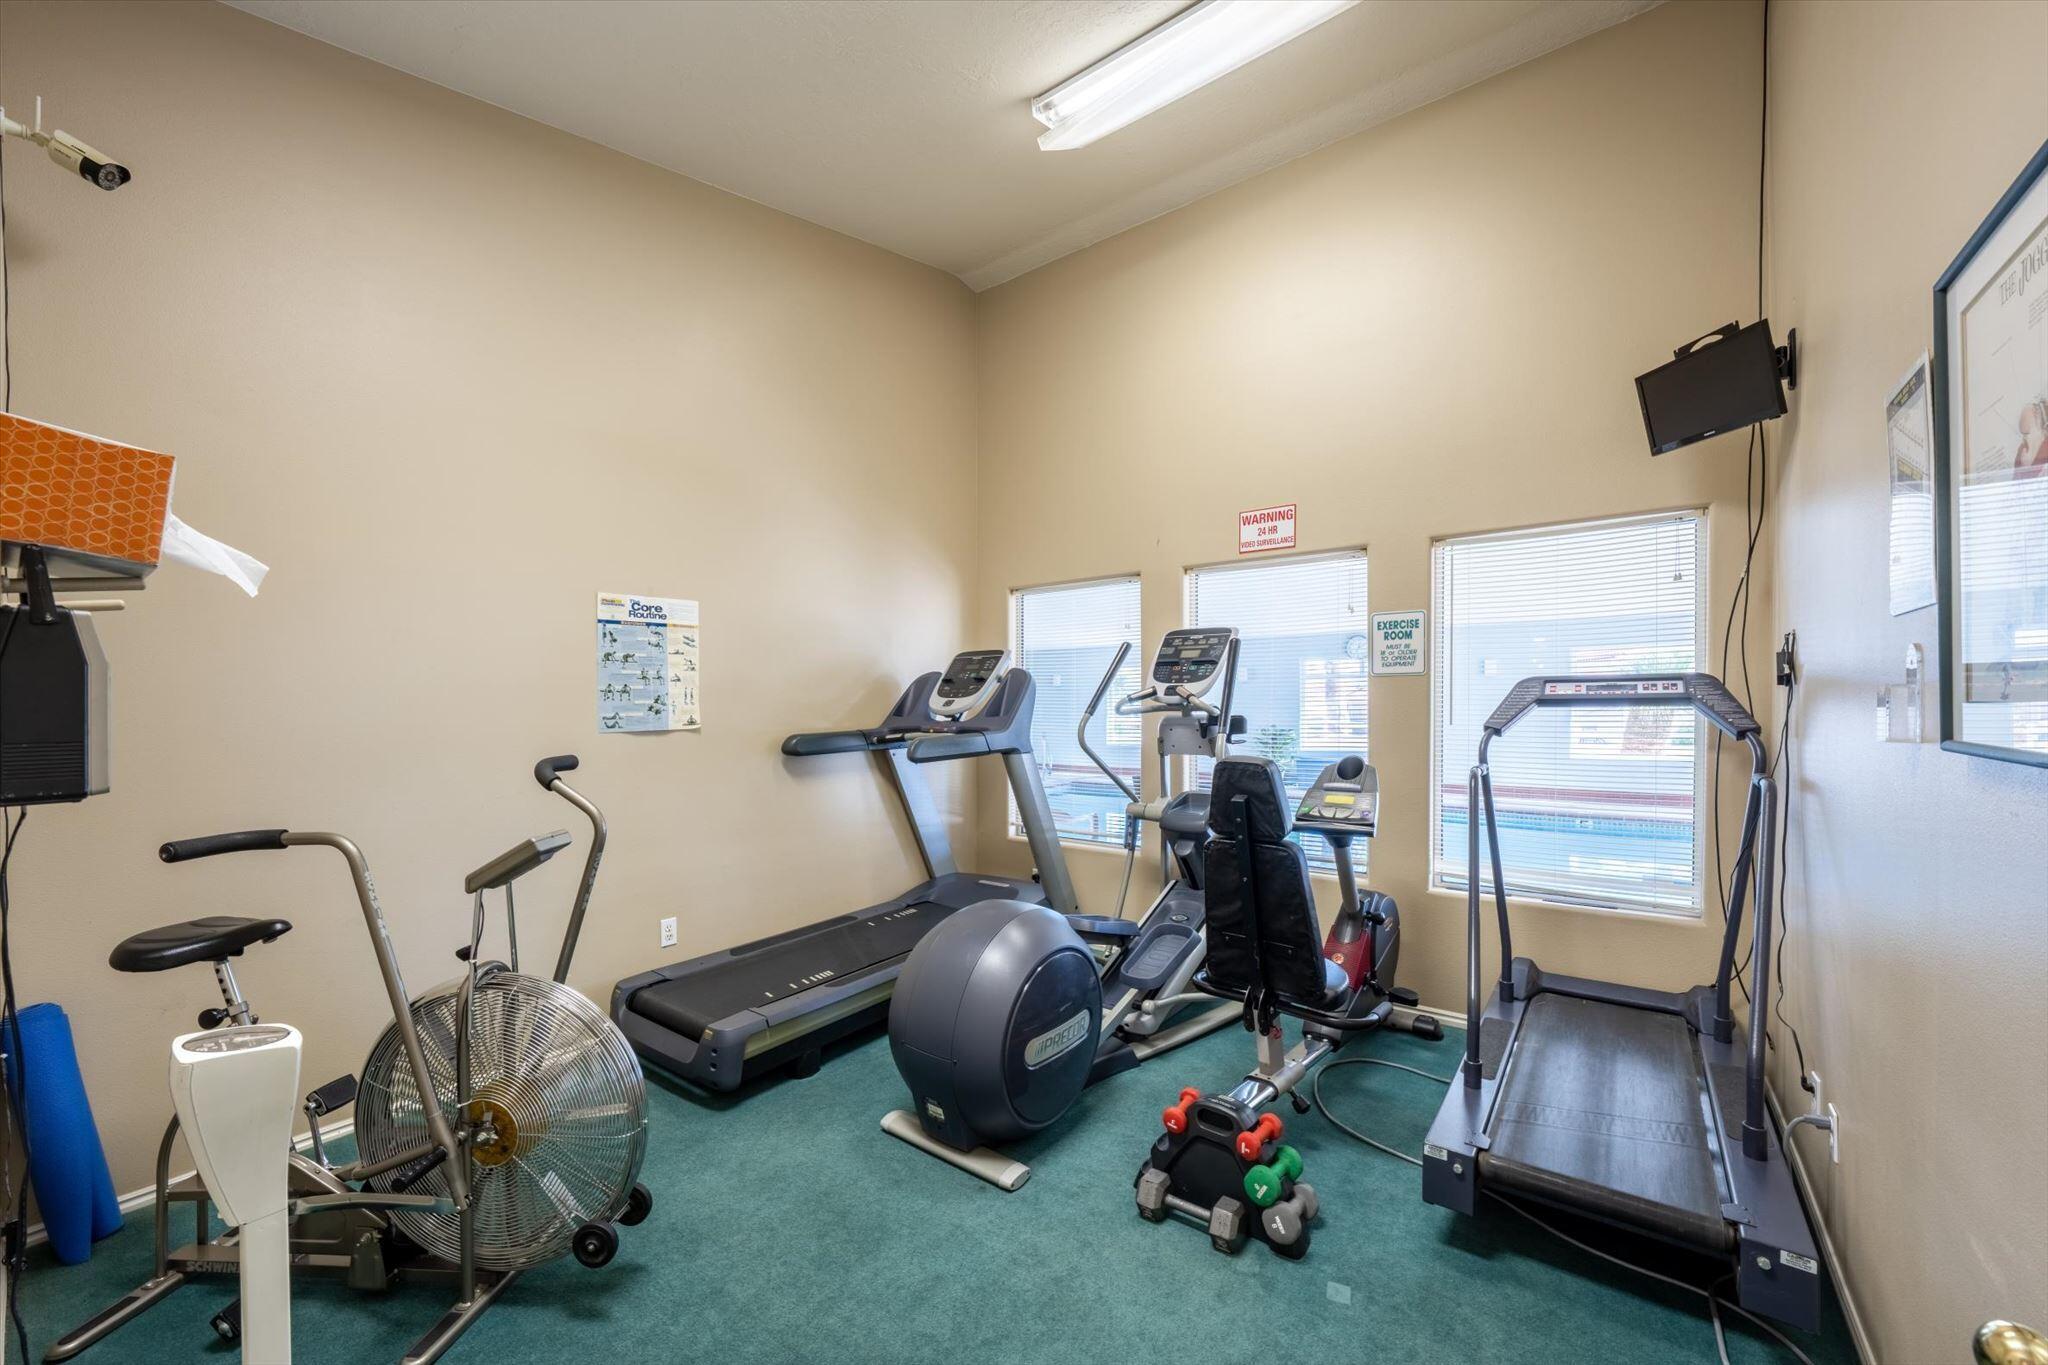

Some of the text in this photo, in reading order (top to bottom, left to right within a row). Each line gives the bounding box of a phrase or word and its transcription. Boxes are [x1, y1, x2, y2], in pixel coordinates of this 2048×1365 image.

[2000, 270, 2016, 305] THE
[1242, 509, 1293, 526] WARNING
[1257, 525, 1278, 536] 24 HR
[1241, 536, 1294, 548] VIDEO SURVEILLANCE
[631, 602, 663, 613] Core
[628, 610, 667, 620] Routine
[1377, 619, 1419, 630] EXERCISE
[1383, 630, 1412, 641] ROOM
[1044, 1016, 1087, 1054] PRECOR
